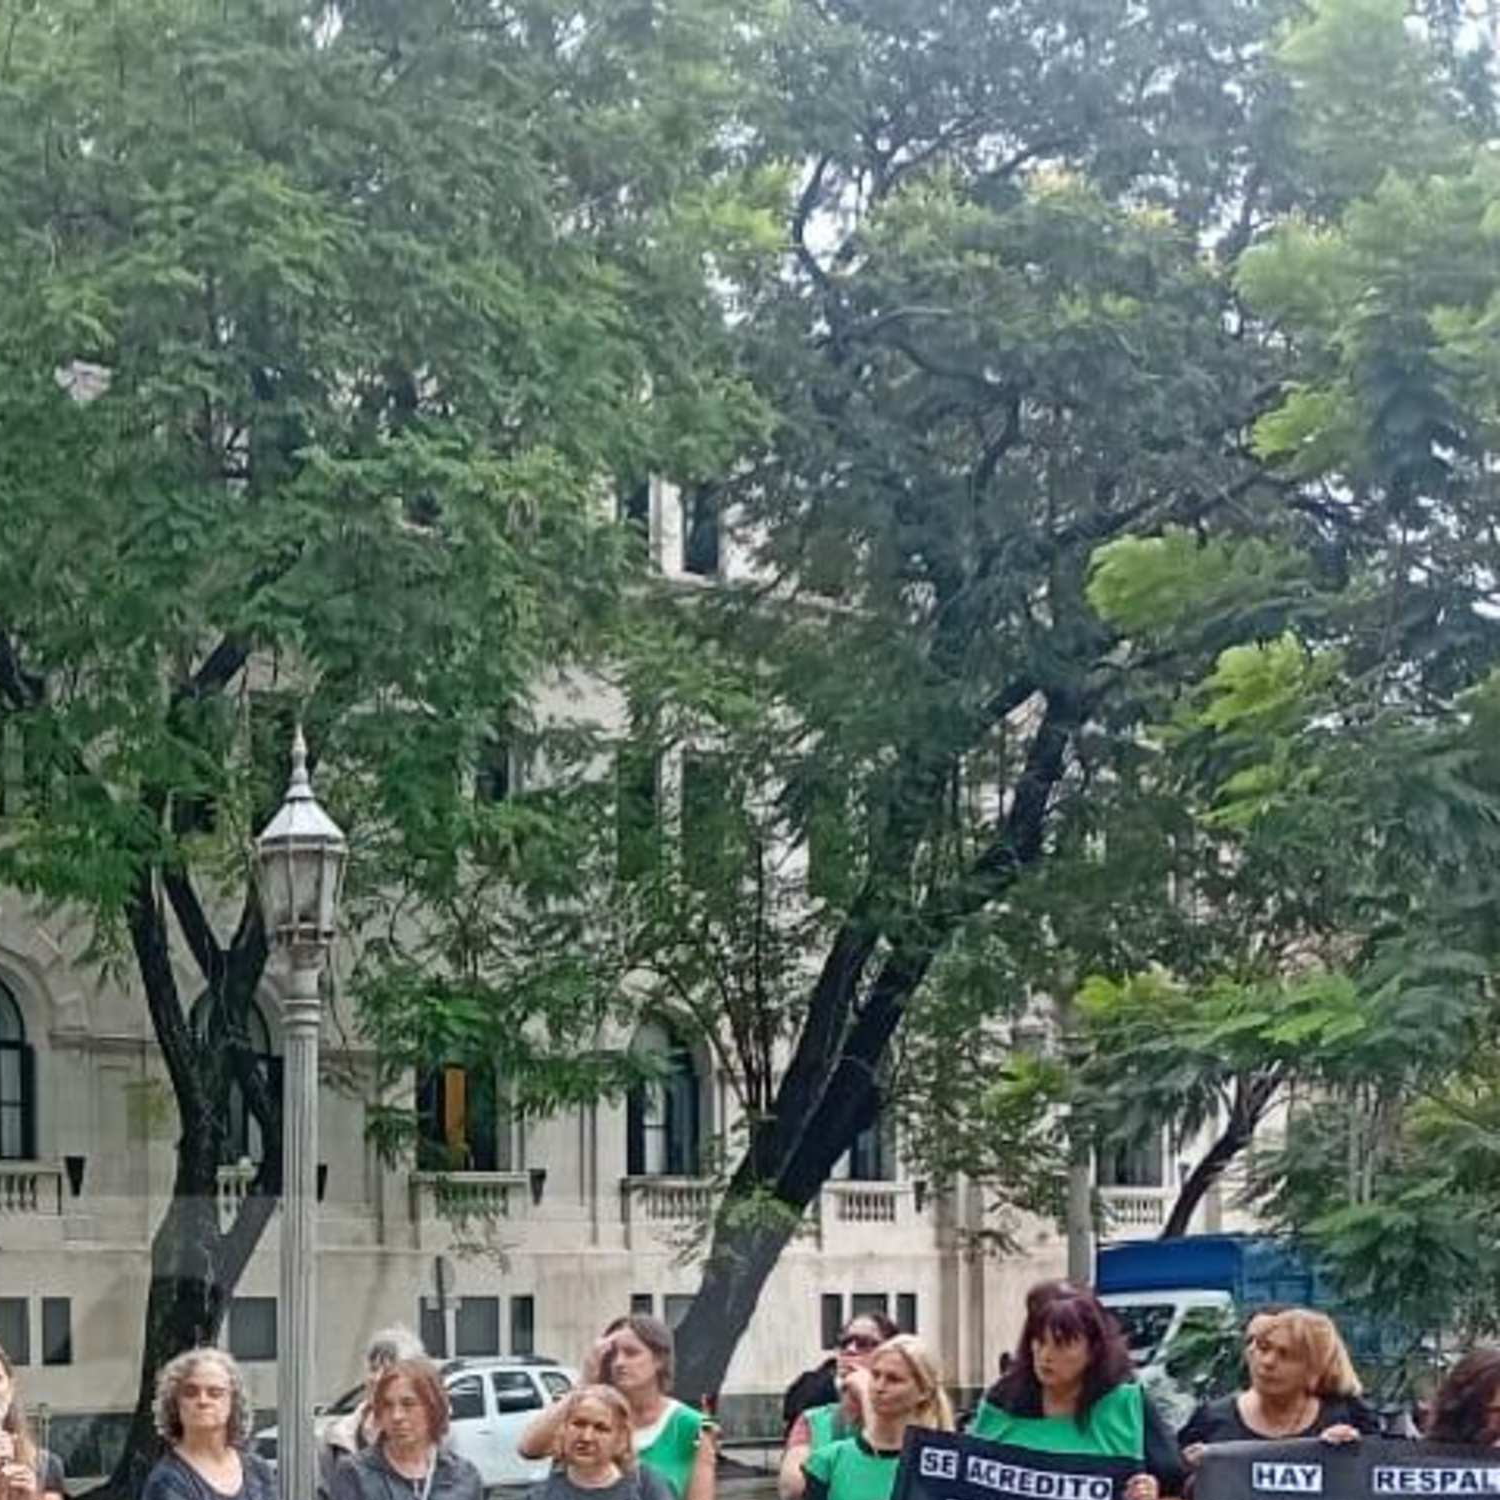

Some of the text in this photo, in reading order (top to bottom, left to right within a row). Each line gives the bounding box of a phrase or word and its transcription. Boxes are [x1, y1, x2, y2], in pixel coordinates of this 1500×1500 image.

[923, 1451, 1111, 1500] SE ACREDITO
[1255, 1466, 1499, 1491] HAY RESPAL
